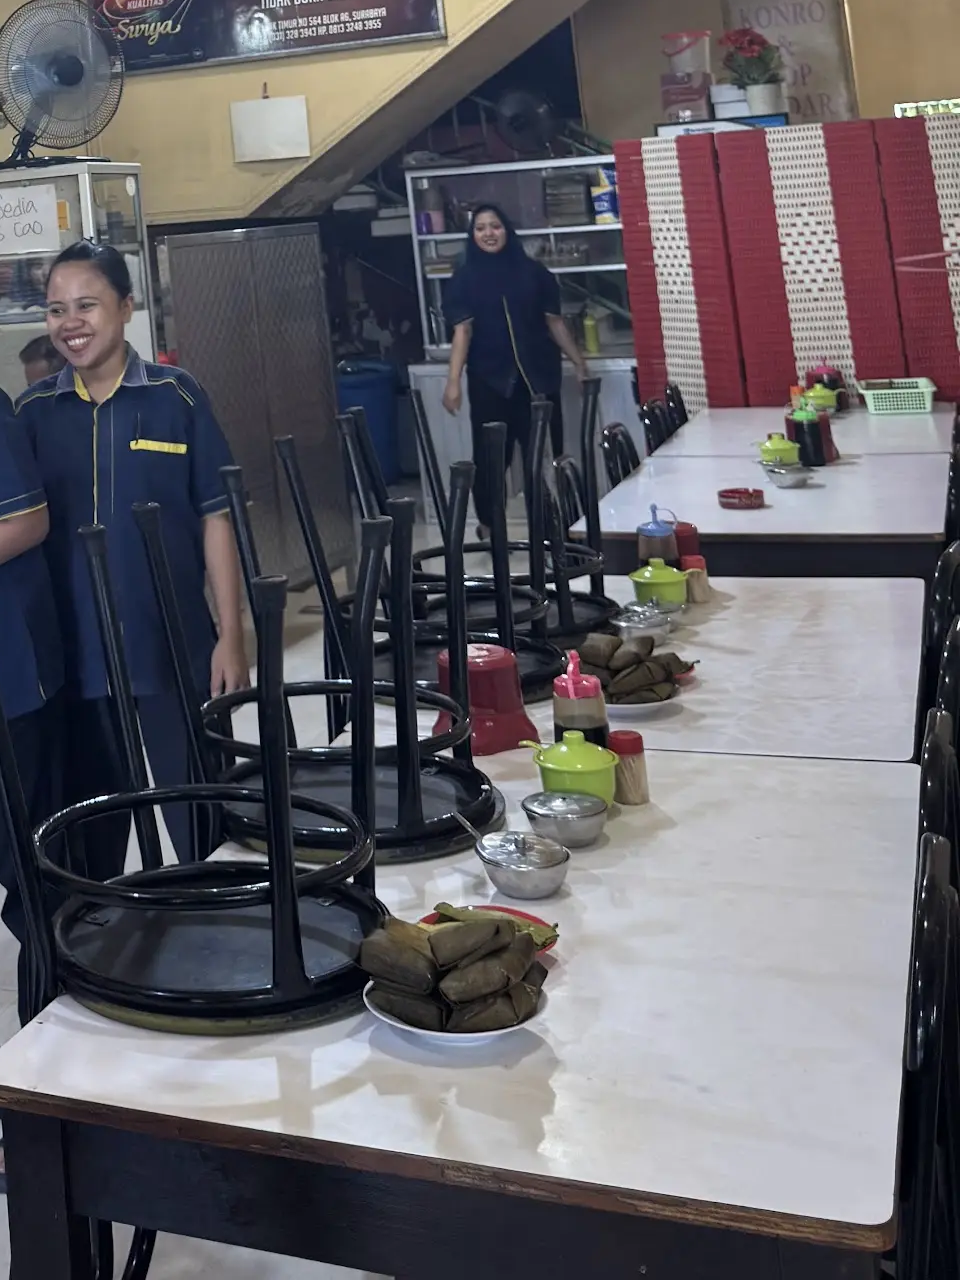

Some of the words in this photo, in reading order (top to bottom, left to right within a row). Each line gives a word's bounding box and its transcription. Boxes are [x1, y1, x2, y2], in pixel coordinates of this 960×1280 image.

[322, 13, 339, 24] BLOK
[740, 0, 826, 29] KONRO
[117, 19, 181, 46] Surya
